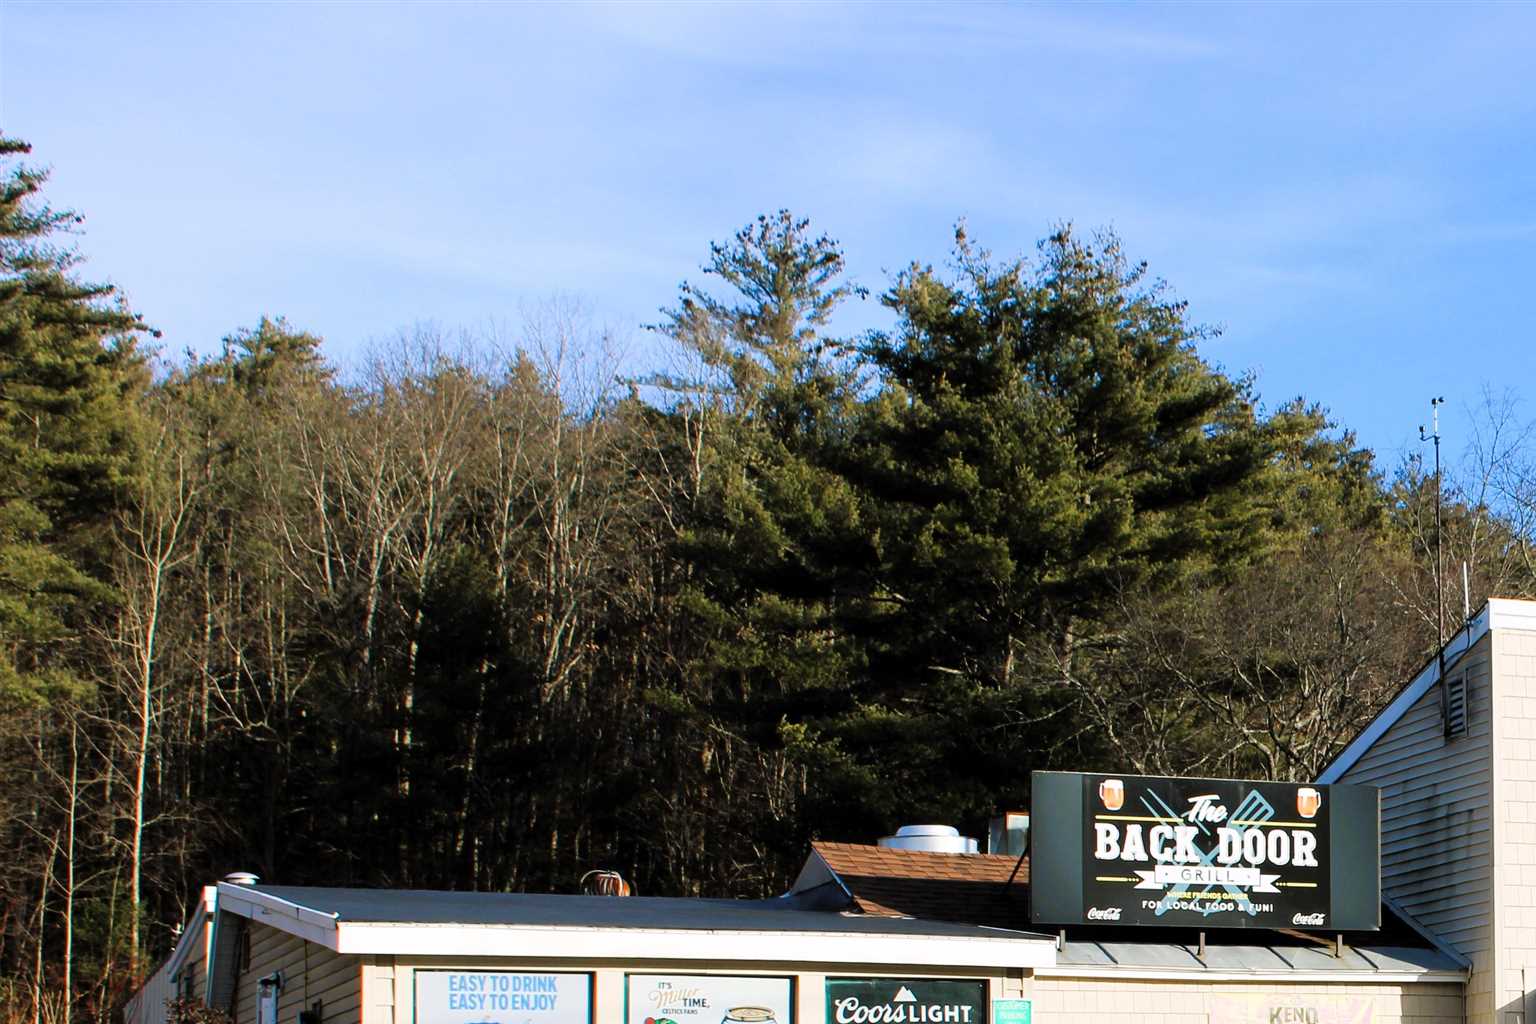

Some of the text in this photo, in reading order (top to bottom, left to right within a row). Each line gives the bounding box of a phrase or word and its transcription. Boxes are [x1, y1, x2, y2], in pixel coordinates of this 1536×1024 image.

[1185, 794, 1228, 823] The
[1094, 823, 1318, 867] BACK DOOR
[1181, 868, 1234, 882] GRILL
[1192, 892, 1221, 900] FRIENDS
[1142, 900, 1163, 910] FOR
[1167, 901, 1202, 911] LOCAL
[1205, 902, 1235, 912] FOOD
[449, 975, 558, 993] EASY TO DRINK
[449, 993, 558, 1011] EASY TO ENJOY
[834, 996, 972, 1024] Coors LIGHT
